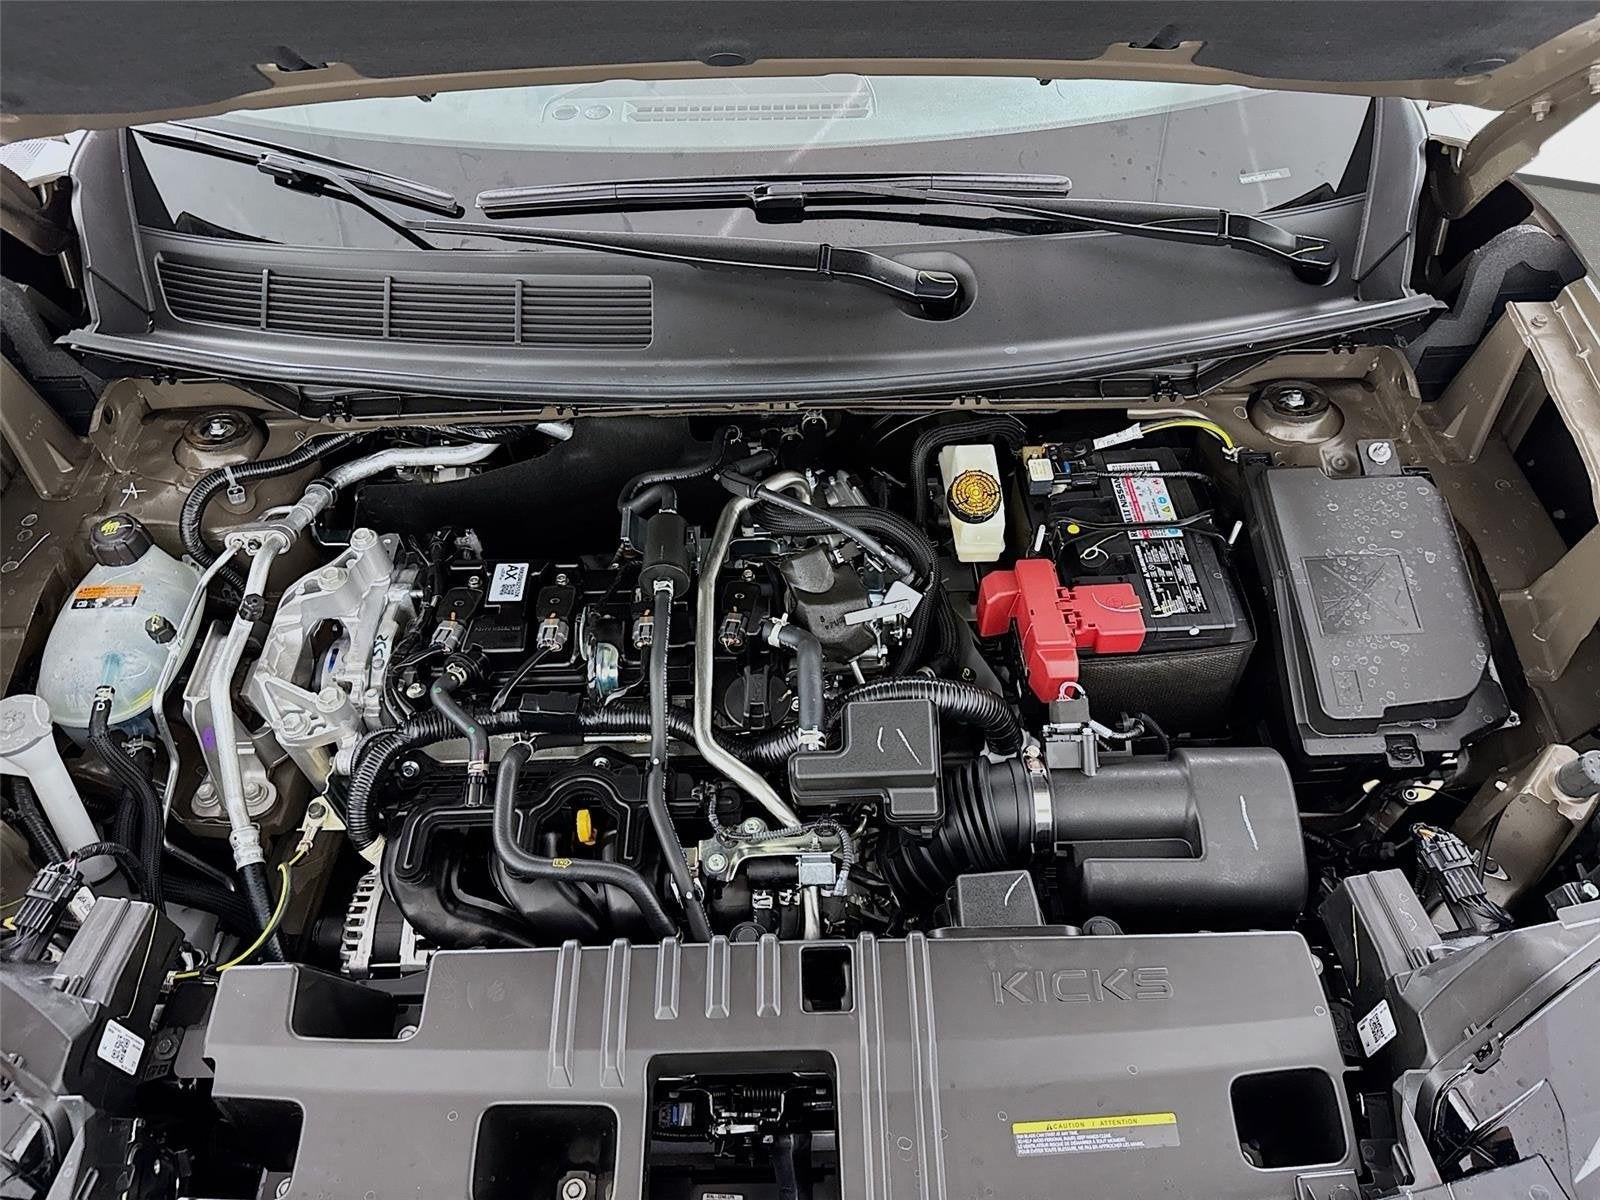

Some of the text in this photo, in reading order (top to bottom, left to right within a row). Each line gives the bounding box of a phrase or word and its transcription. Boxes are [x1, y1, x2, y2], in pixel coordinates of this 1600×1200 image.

[1113, 478, 1128, 507] NISSAN
[505, 565, 519, 580] AX
[992, 967, 1175, 1005] KICKS
